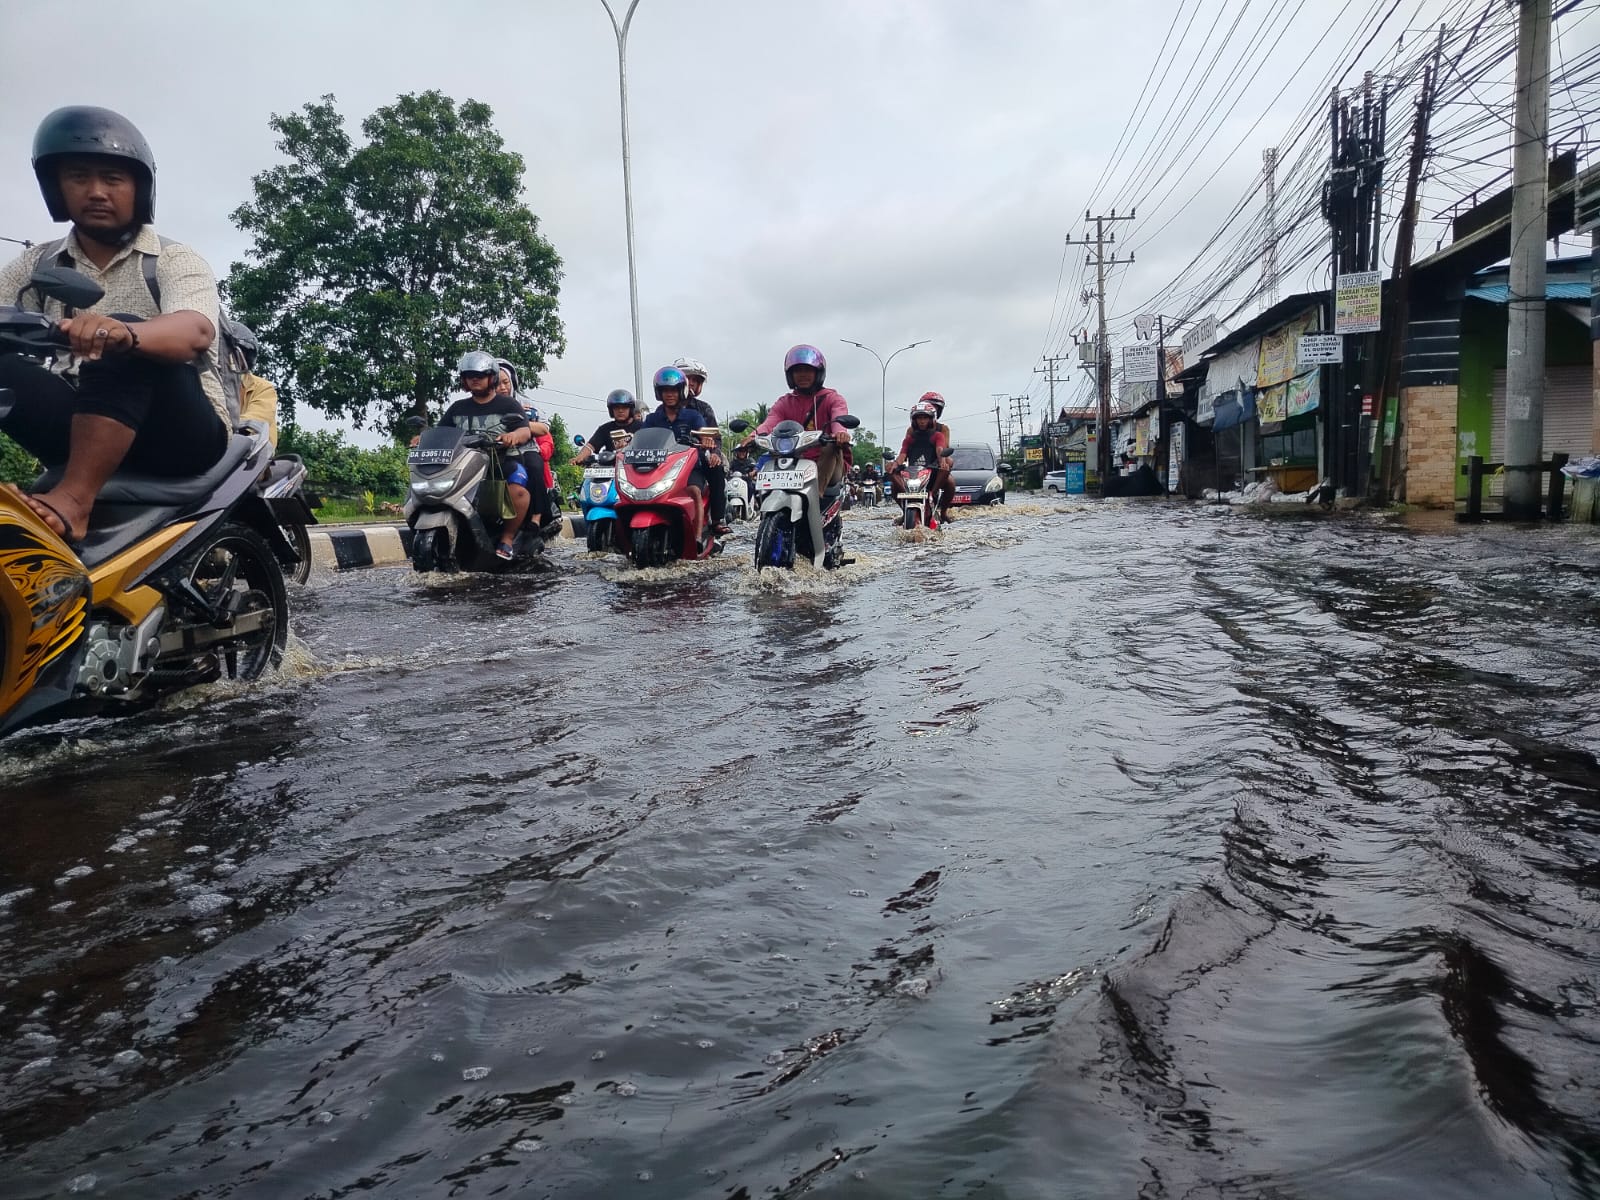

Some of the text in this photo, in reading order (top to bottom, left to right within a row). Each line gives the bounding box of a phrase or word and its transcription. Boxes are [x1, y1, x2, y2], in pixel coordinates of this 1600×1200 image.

[759, 473, 768, 481] DA
[772, 472, 790, 480] 3527
[793, 471, 804, 480] NN
